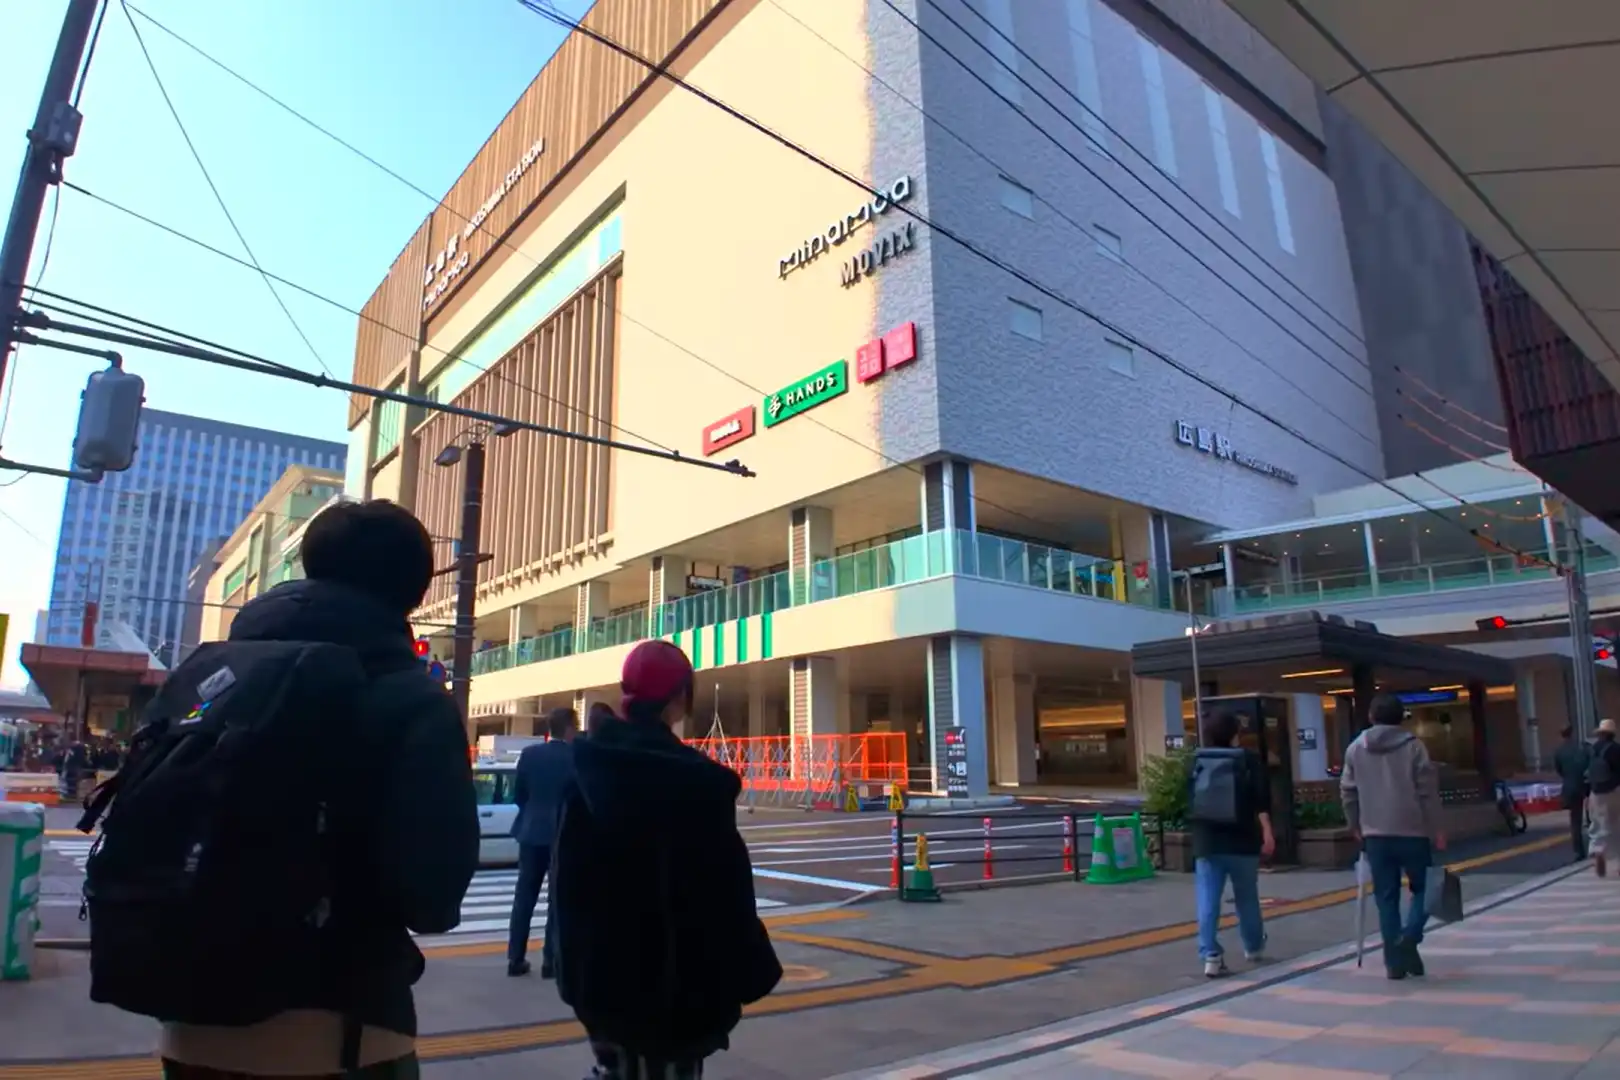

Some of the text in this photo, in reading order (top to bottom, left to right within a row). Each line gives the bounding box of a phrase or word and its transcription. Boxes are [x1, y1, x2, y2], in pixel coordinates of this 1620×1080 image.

[780, 175, 910, 279] minamoa
[842, 222, 914, 287] MOVIX
[786, 371, 836, 406] HANDS
[1176, 419, 1232, 461] 広島駅
